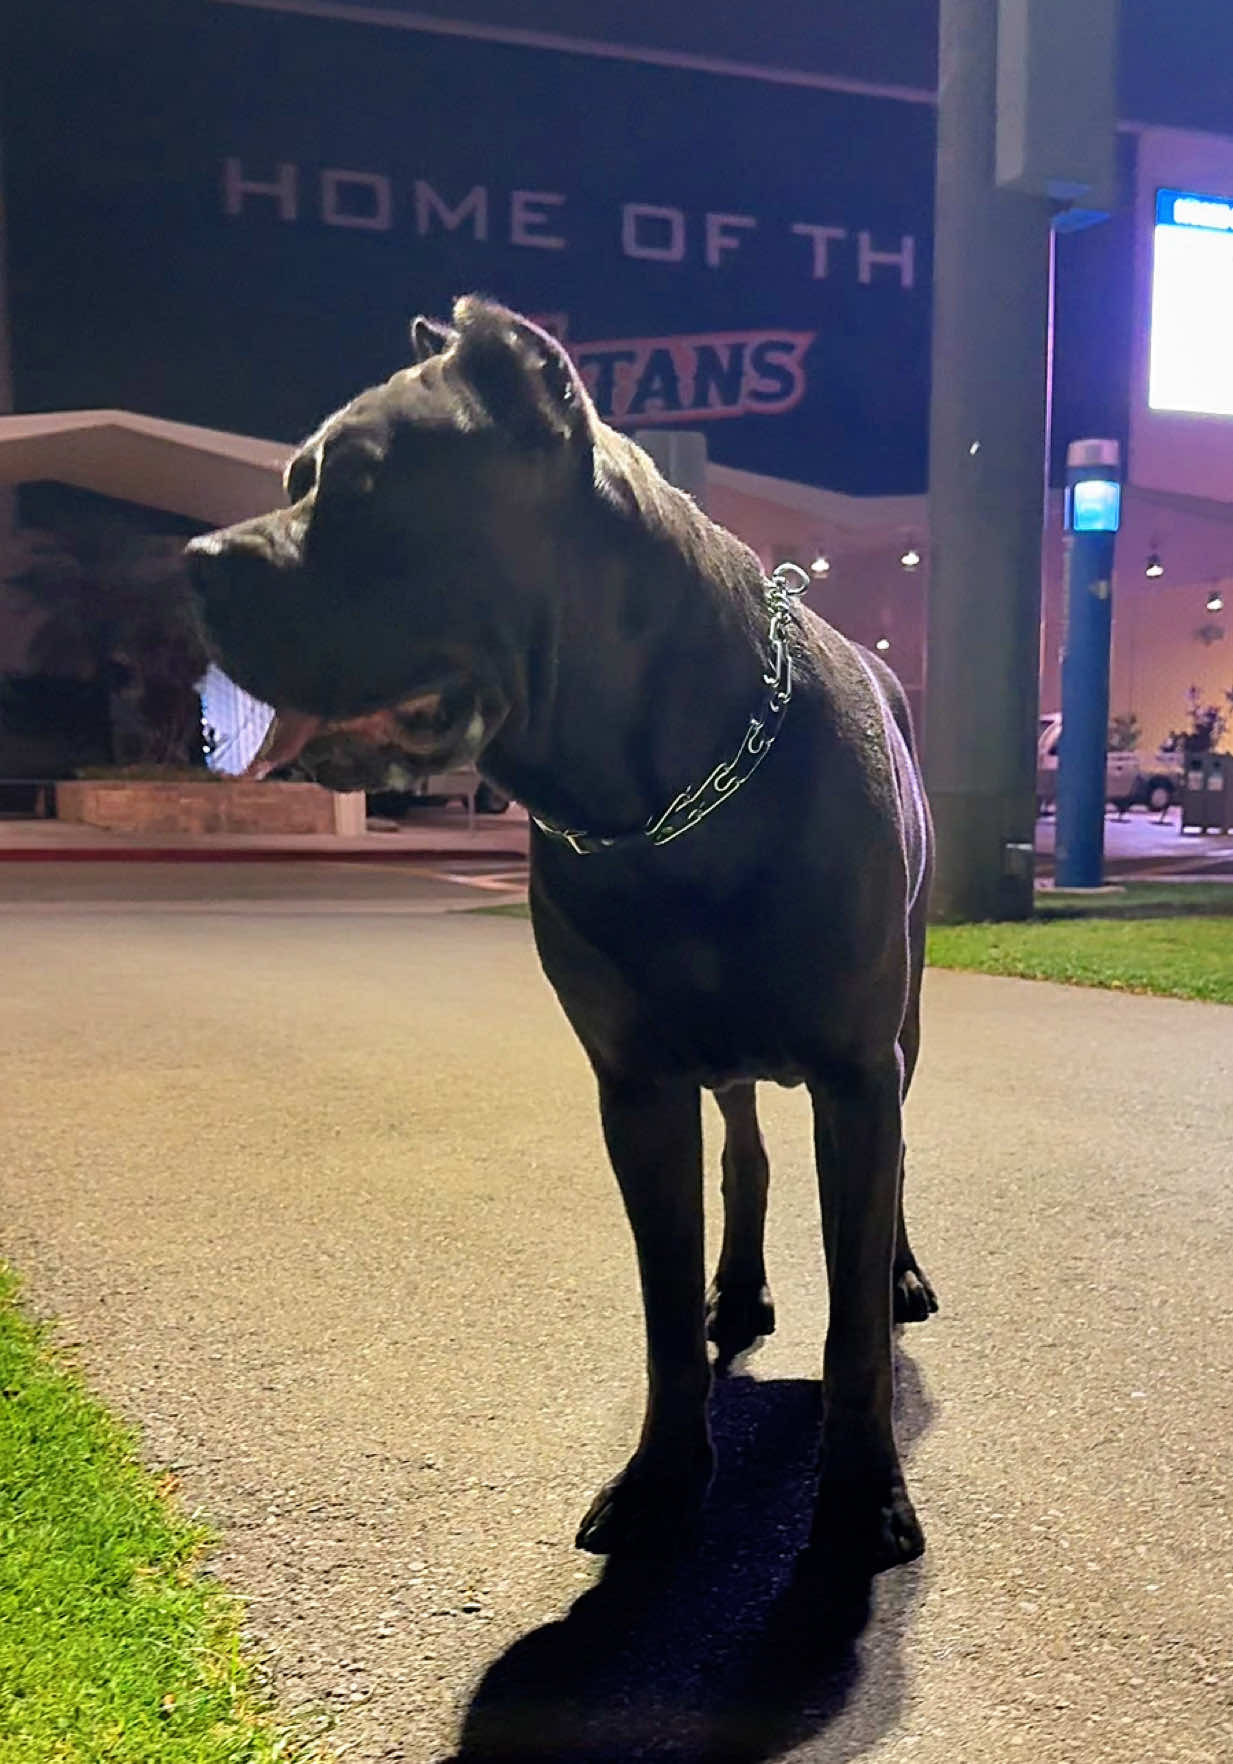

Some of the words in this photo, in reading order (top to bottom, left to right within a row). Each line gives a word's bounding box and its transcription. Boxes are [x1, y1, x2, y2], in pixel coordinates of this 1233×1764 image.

[222, 157, 566, 250] HOME
[621, 202, 757, 268] OF
[793, 221, 915, 289] TH
[537, 314, 798, 416] TANS
